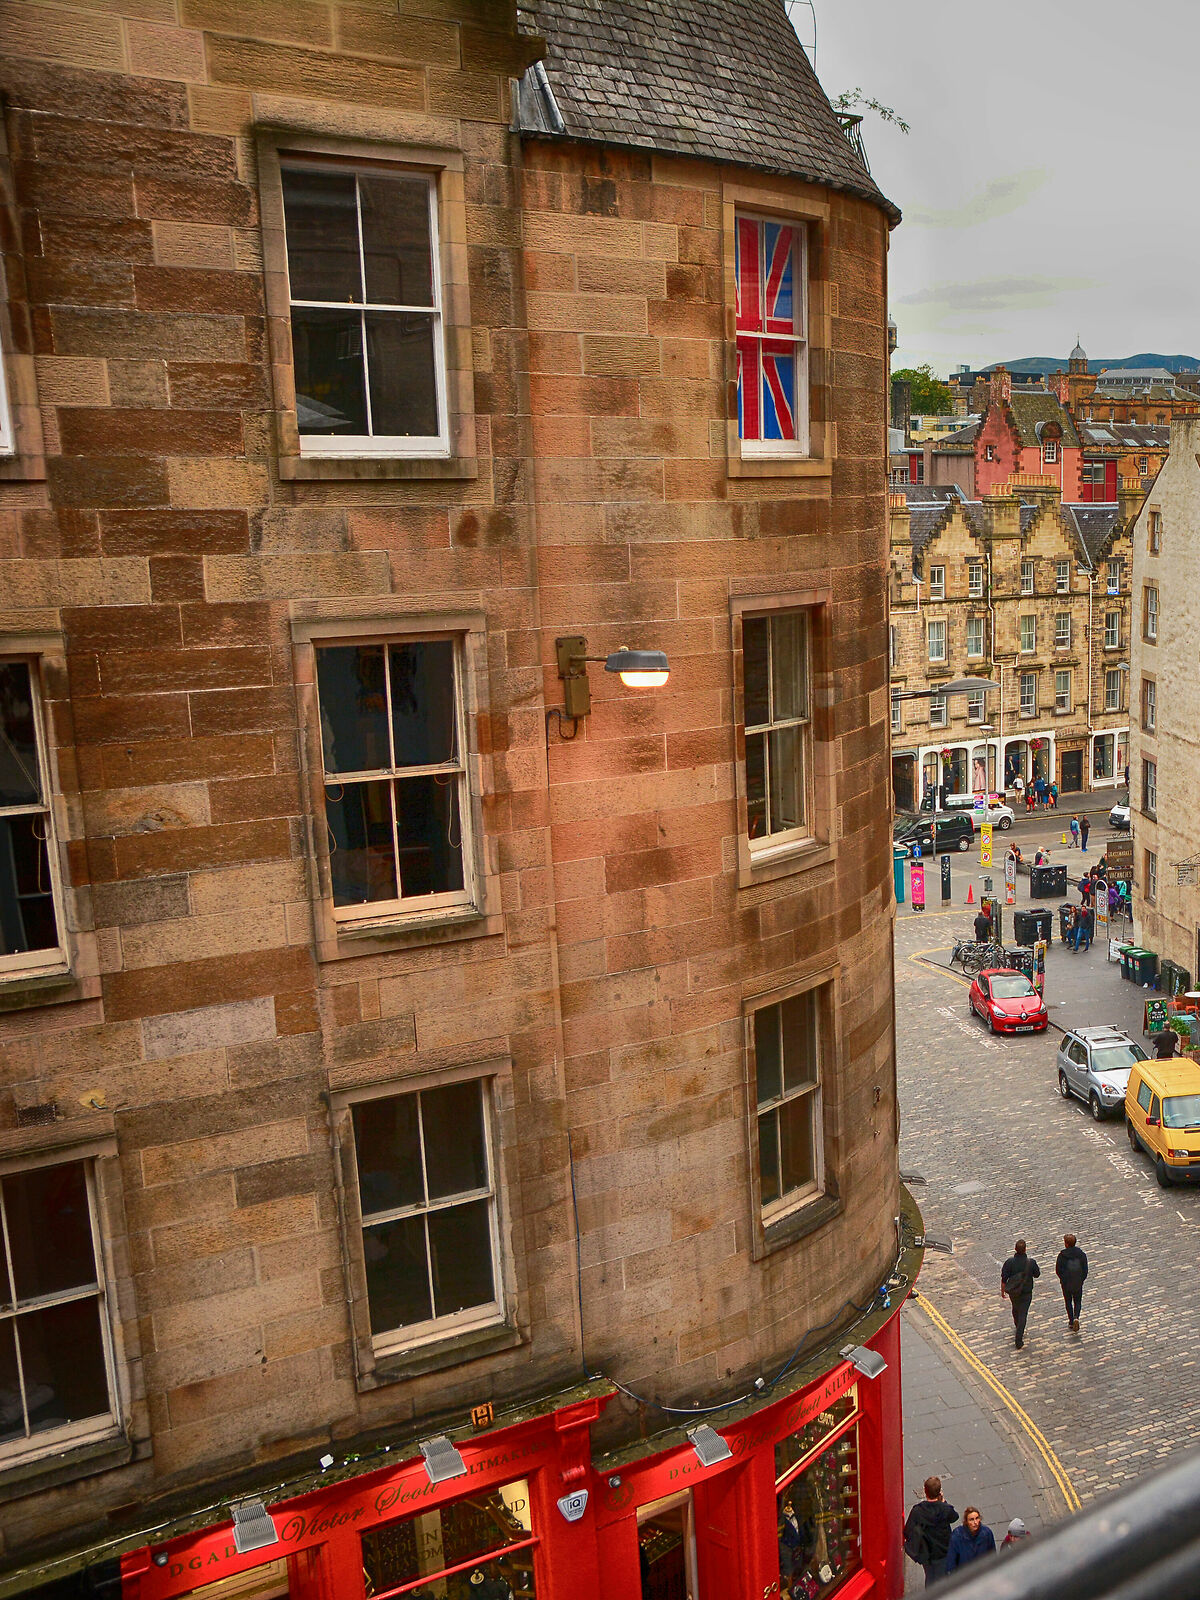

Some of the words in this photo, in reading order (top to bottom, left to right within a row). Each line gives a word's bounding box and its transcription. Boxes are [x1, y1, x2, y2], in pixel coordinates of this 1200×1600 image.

[1079, 1127, 1111, 1148] PERMIT
[1104, 1151, 1139, 1179] HOLDERS
[1137, 1189, 1164, 1210] ONLY
[169, 1544, 241, 1579] DGAD
[281, 1502, 365, 1543] Victor
[374, 1480, 439, 1516] Scott
[452, 1441, 547, 1481] ILTMAKERS
[669, 1460, 703, 1480] DGA
